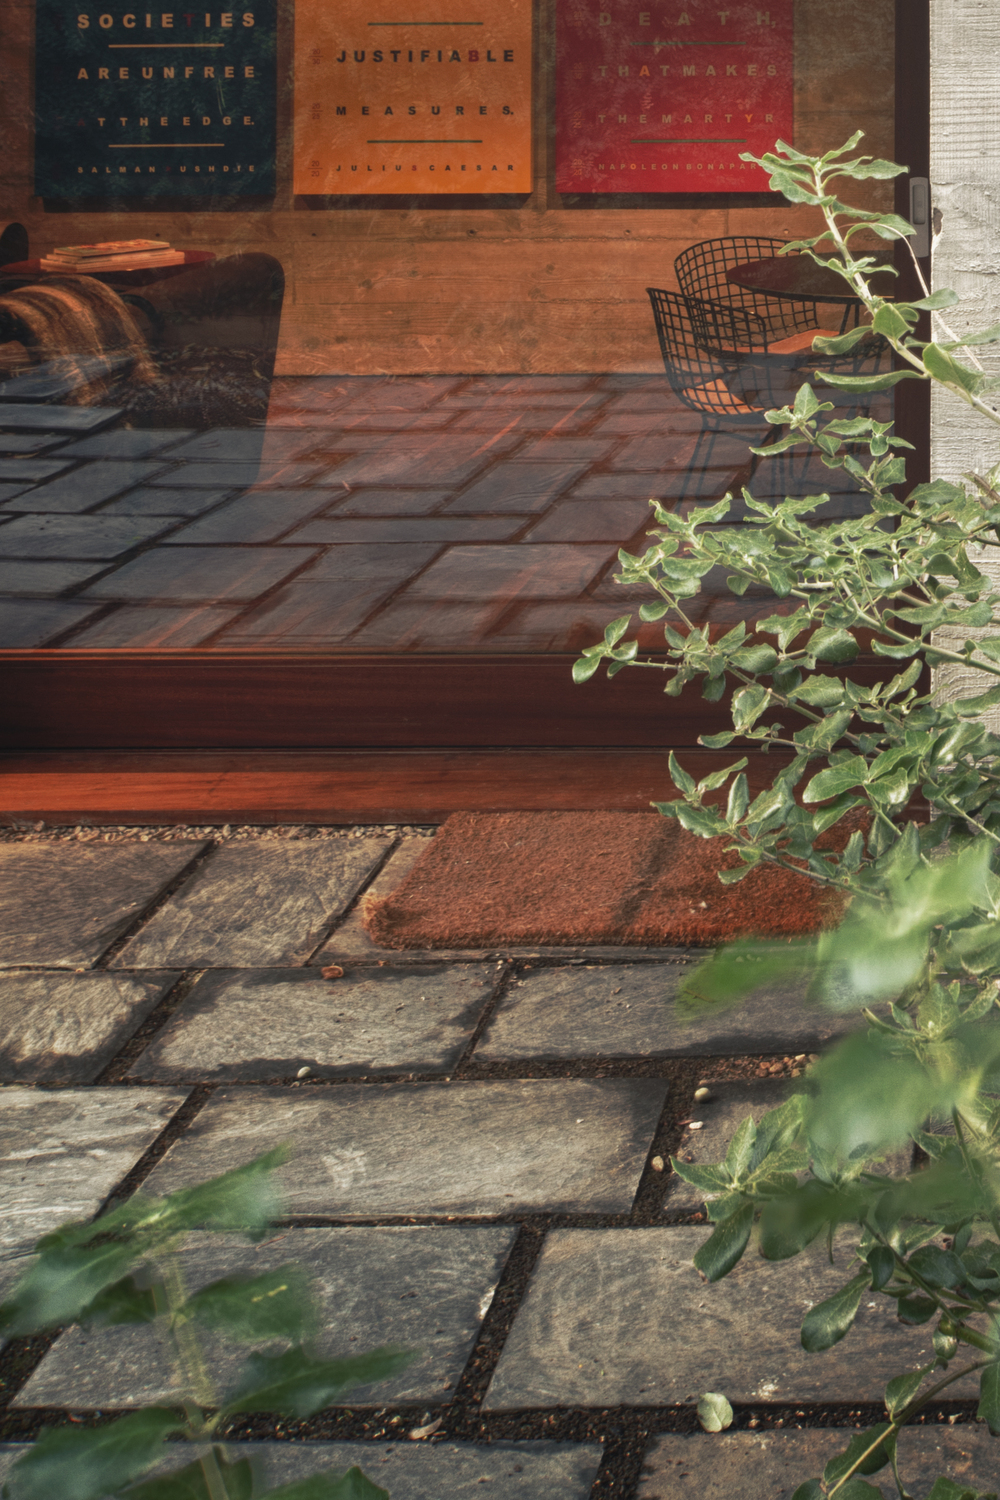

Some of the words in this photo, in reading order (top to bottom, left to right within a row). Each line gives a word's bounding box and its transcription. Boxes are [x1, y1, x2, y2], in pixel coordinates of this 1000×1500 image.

[77, 13, 255, 29] SOCIETIES
[336, 50, 514, 63] JUSTIFIABLE
[141, 66, 255, 80] UNFREE
[682, 64, 777, 77] MAKES
[336, 105, 514, 116] MEASURES.
[661, 113, 774, 124] MARTYR
[77, 165, 156, 174] SALMAN
[336, 164, 417, 172] JULIUS
[429, 164, 514, 172] CAESAR
[686, 162, 758, 170] BONAPAR
